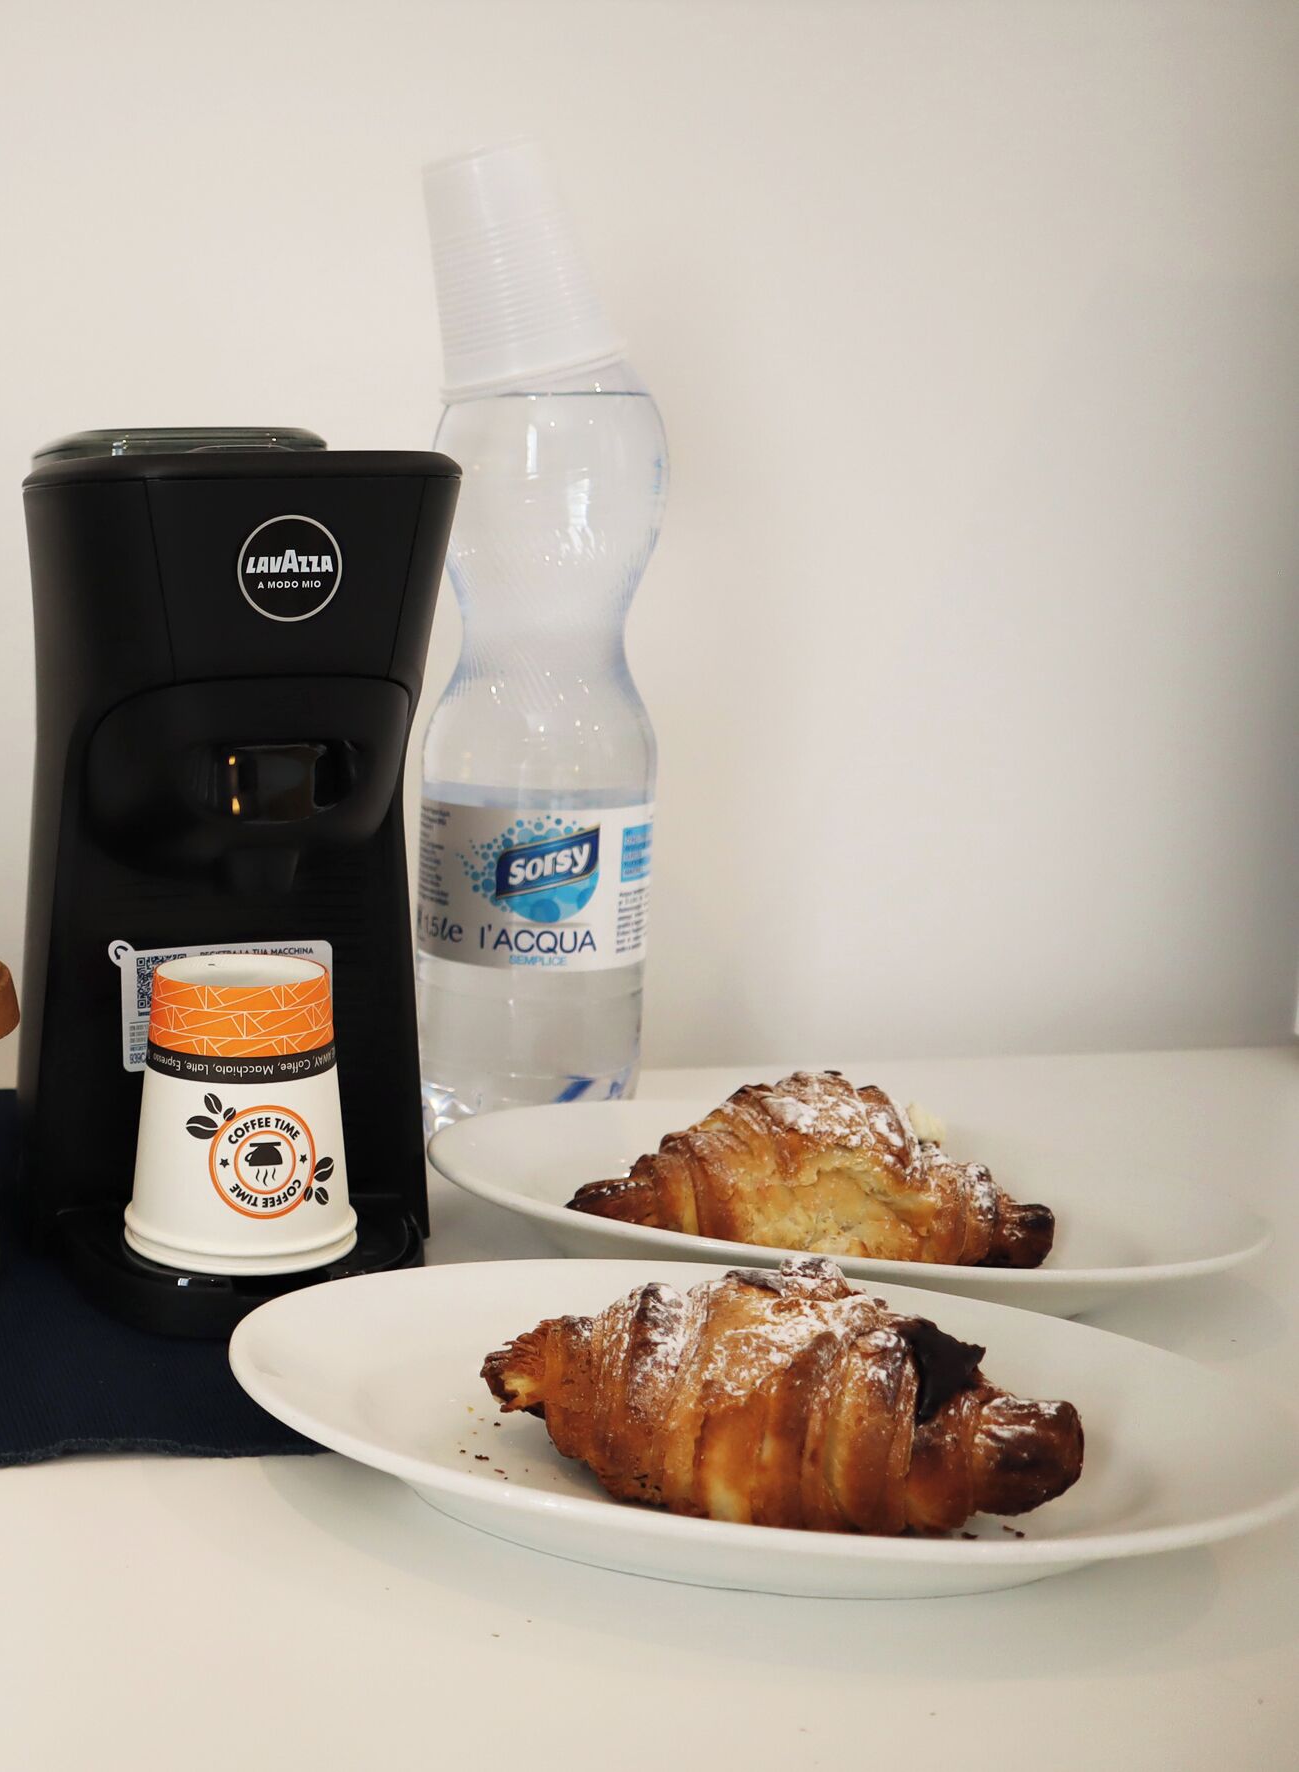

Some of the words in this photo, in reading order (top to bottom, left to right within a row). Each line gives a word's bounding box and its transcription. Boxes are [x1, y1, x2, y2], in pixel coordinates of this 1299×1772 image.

[246, 549, 334, 574] LAVAZZA
[257, 581, 265, 589] A
[267, 580, 299, 589] MODO
[301, 580, 322, 588] MIO
[270, 947, 314, 956] MACCHINA
[509, 955, 568, 966] SEMPLICE
[183, 1060, 209, 1075] Latte,
[212, 1063, 274, 1077] Macchiato,
[277, 1059, 311, 1073] Coffee,
[227, 1117, 271, 1145] COFFEE
[274, 1117, 301, 1141] TIME
[229, 1183, 259, 1207] TIME
[261, 1179, 302, 1208] COFFEE
